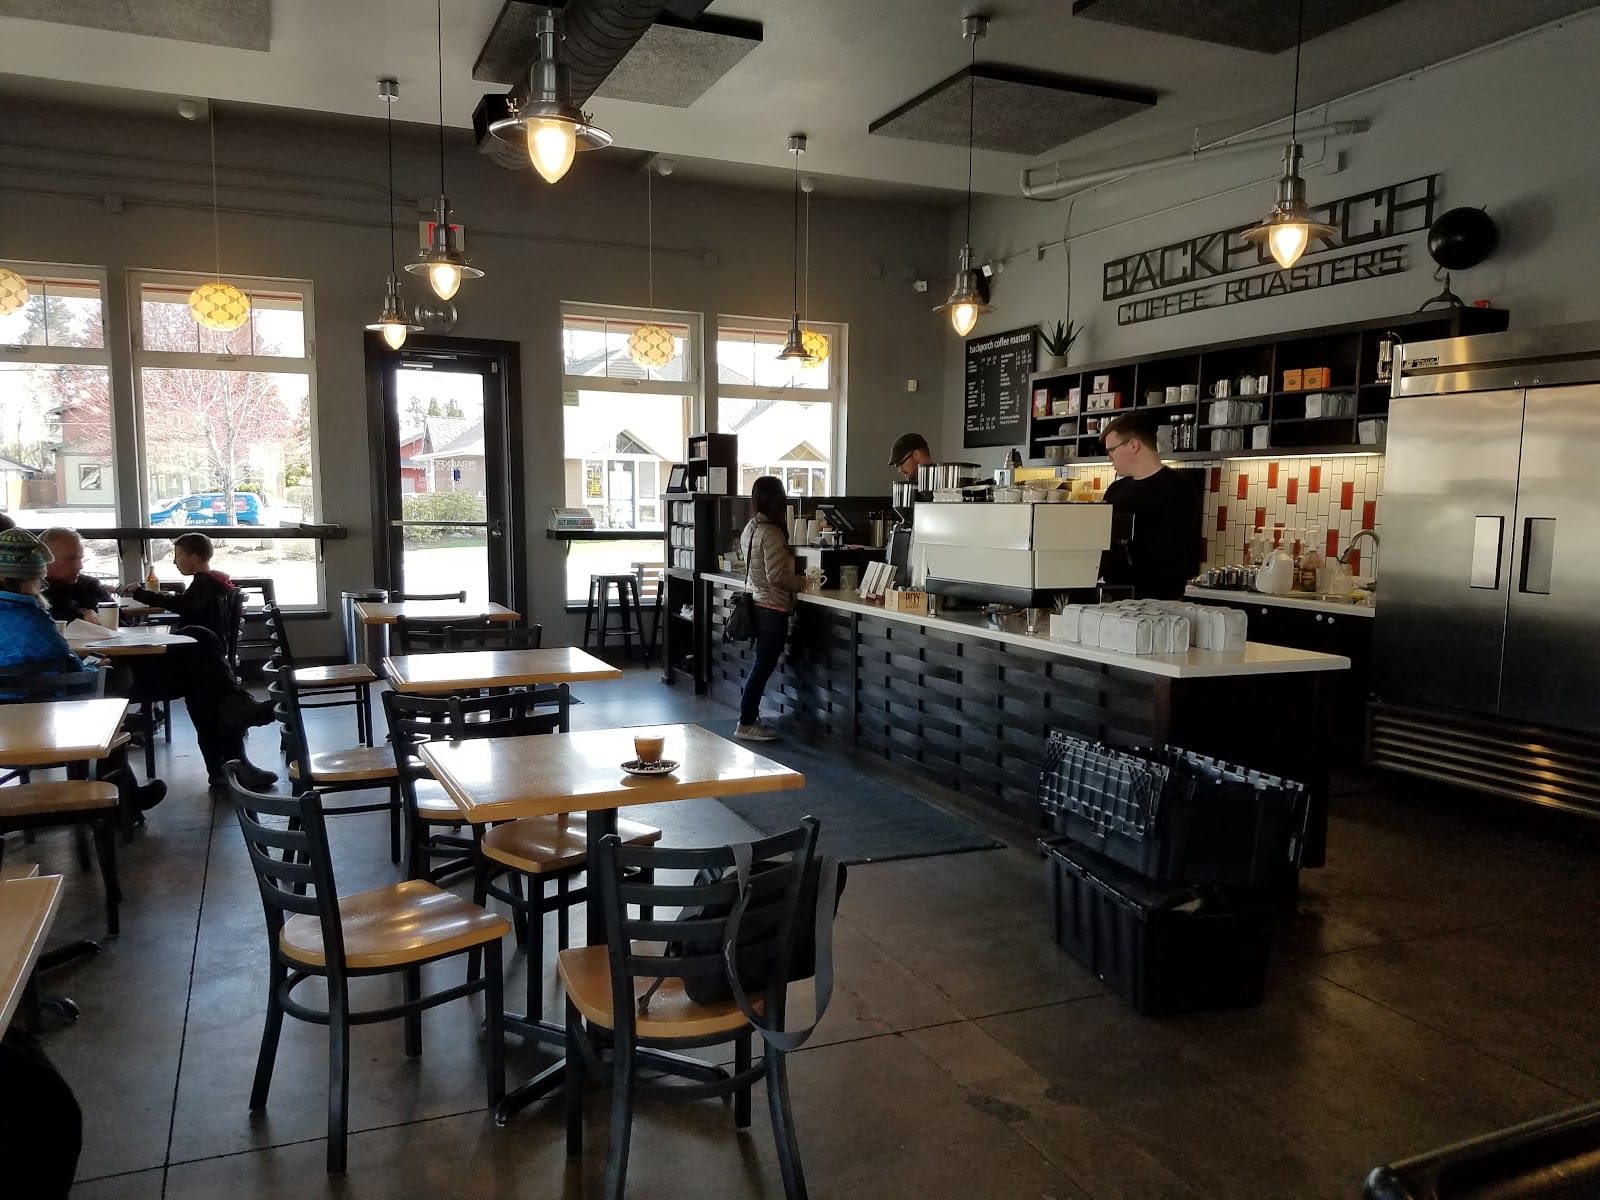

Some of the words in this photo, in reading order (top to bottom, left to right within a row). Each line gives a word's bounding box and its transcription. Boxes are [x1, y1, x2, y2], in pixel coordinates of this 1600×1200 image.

[1103, 174, 1438, 301] BACKPRCH
[1117, 286, 1209, 326] COFFEE
[1225, 244, 1408, 304] ROASTERS
[970, 340, 994, 354] backporch
[994, 336, 1010, 349] coffee
[1010, 333, 1031, 345] roasters
